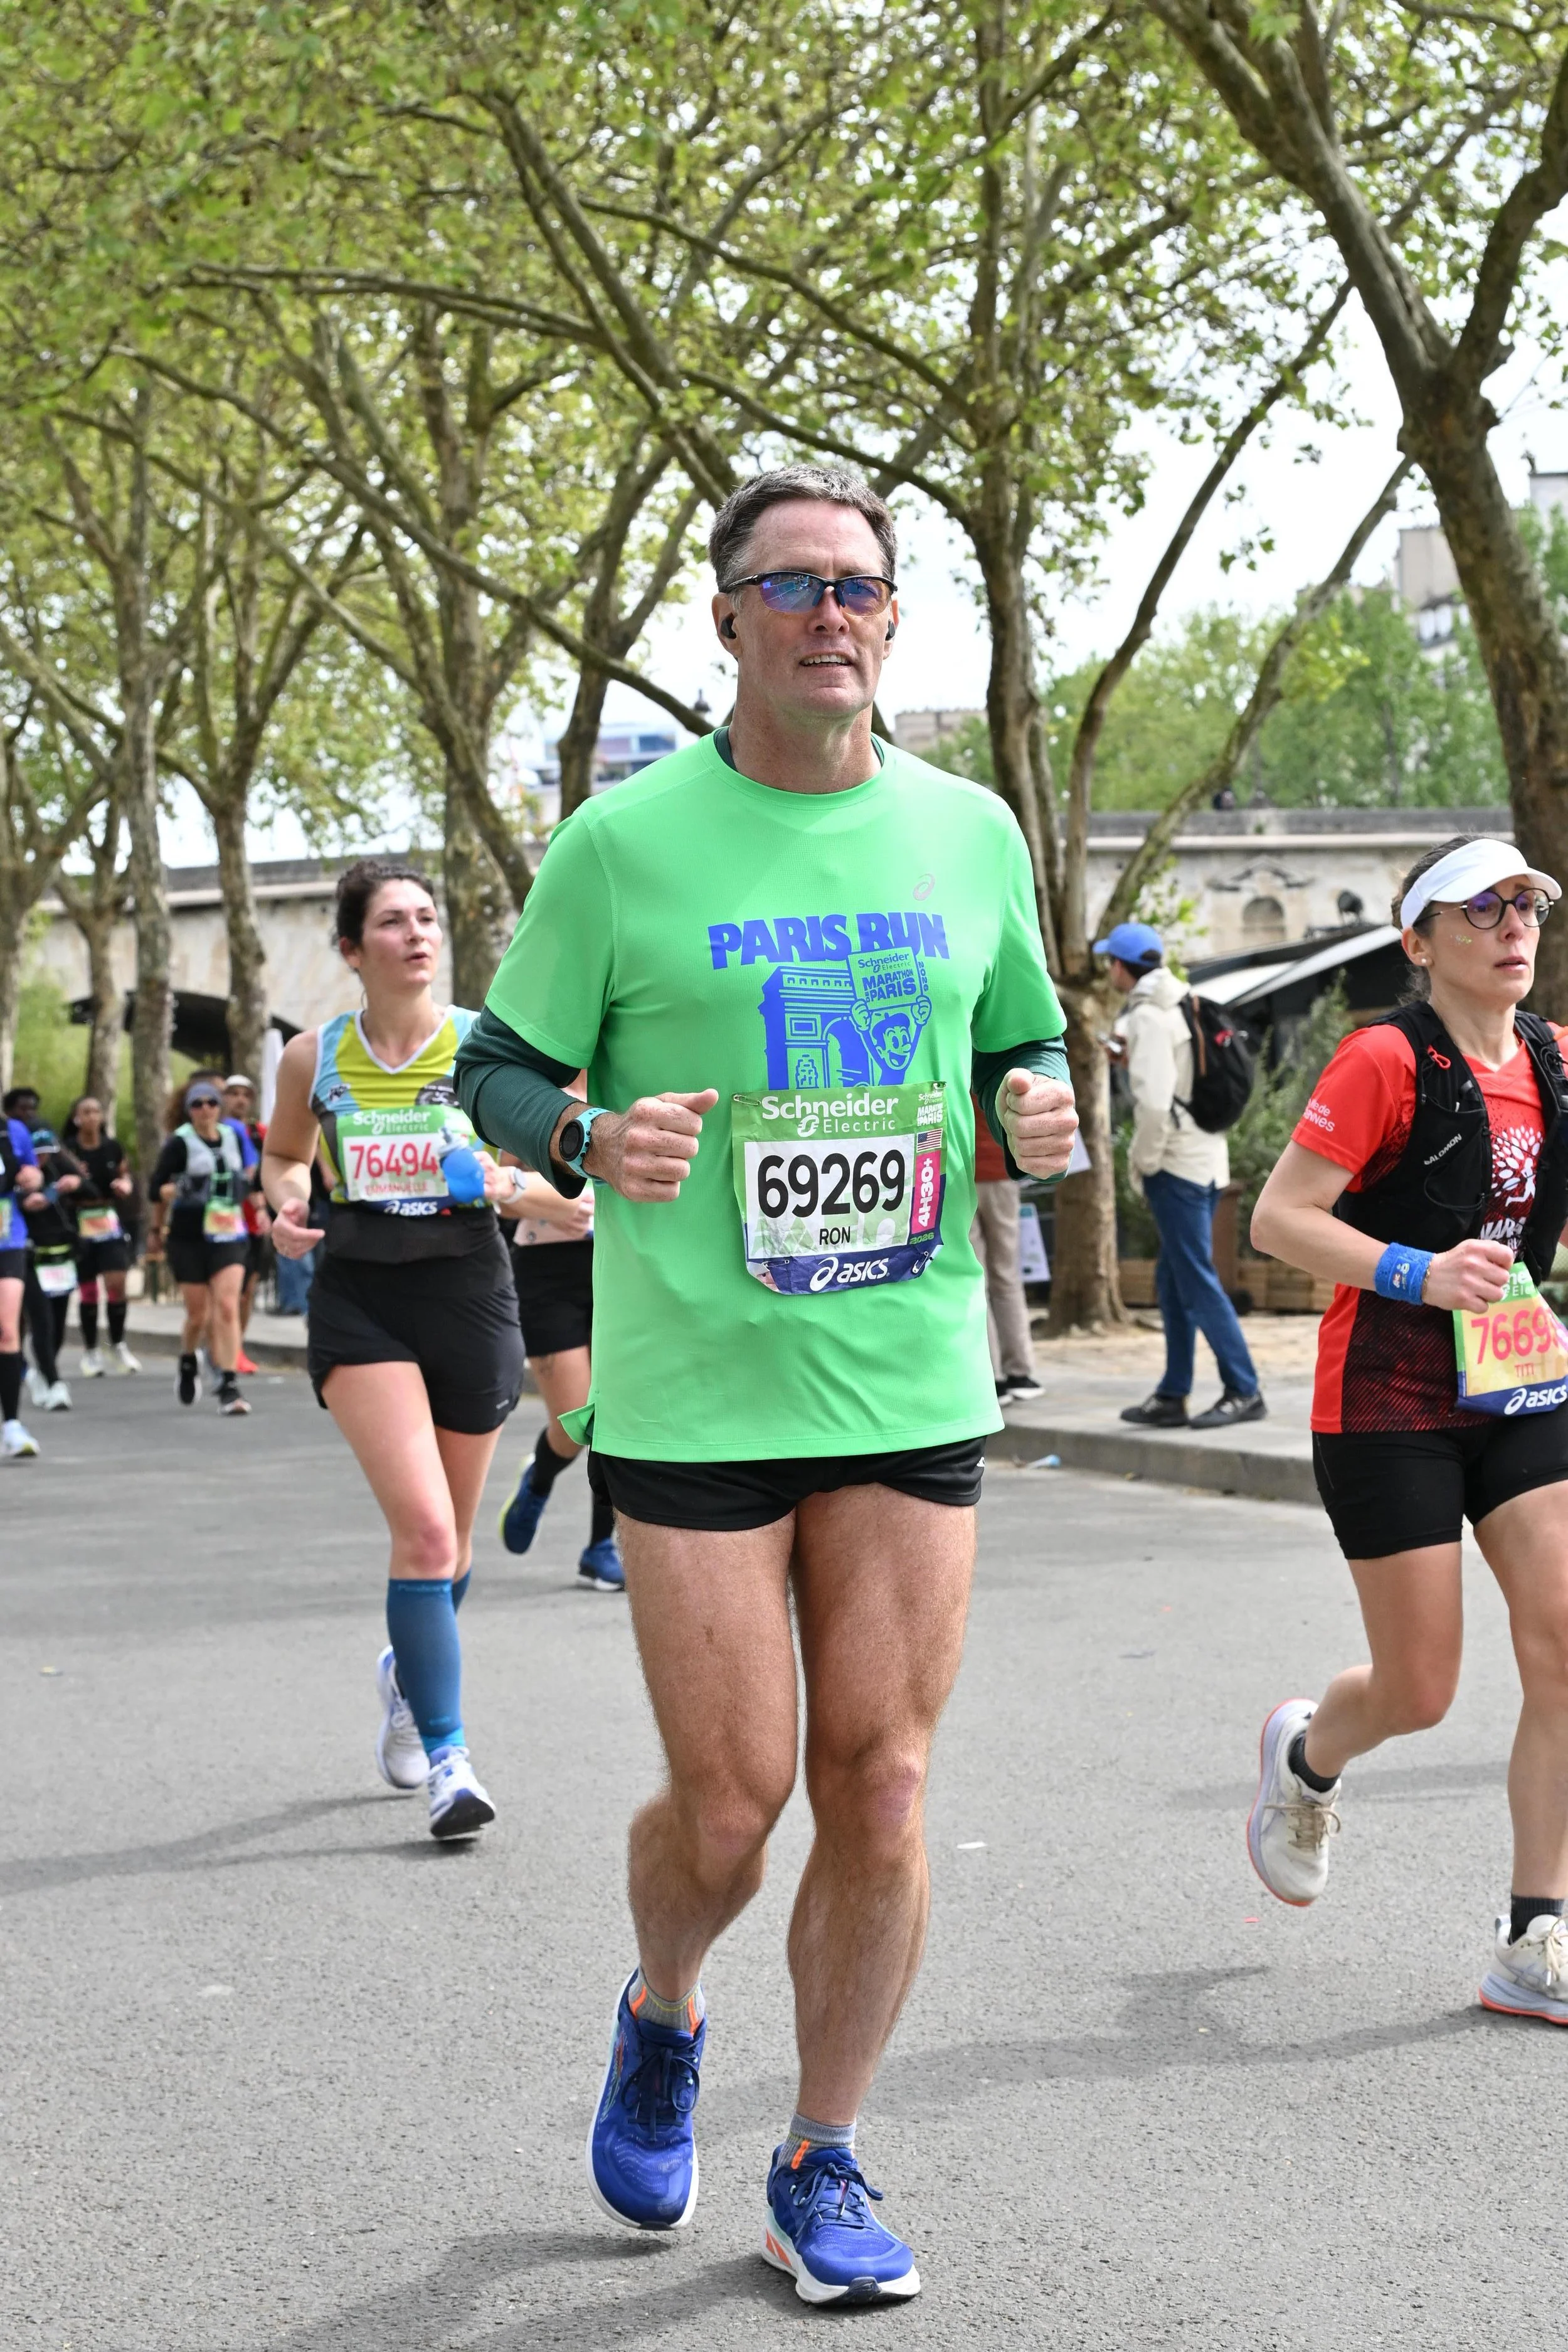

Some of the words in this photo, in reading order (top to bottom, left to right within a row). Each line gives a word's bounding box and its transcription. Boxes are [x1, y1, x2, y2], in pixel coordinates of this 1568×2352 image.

[708, 914, 854, 970] PARIS
[856, 912, 950, 960] RUN
[858, 953, 909, 968] Schneider
[882, 961, 911, 970] Electric
[862, 969, 913, 991] MARATHON
[918, 961, 929, 992] 2026
[870, 977, 916, 1002] PARIS
[353, 1109, 432, 1126] Schneider
[762, 1093, 899, 1120] Schneider
[823, 1118, 896, 1133] Electric
[1303, 1108, 1335, 1132] ennes
[349, 1142, 438, 1179] 76494
[758, 1149, 905, 1218] 69269
[918, 1158, 934, 1227] 4H30+
[819, 1226, 850, 1246] RON
[909, 1232, 935, 1245] 2026
[837, 1258, 889, 1284] asics
[1471, 1306, 1558, 1365] 7669
[1515, 1362, 1535, 1378] TITI
[1526, 1384, 1567, 1408] asics
